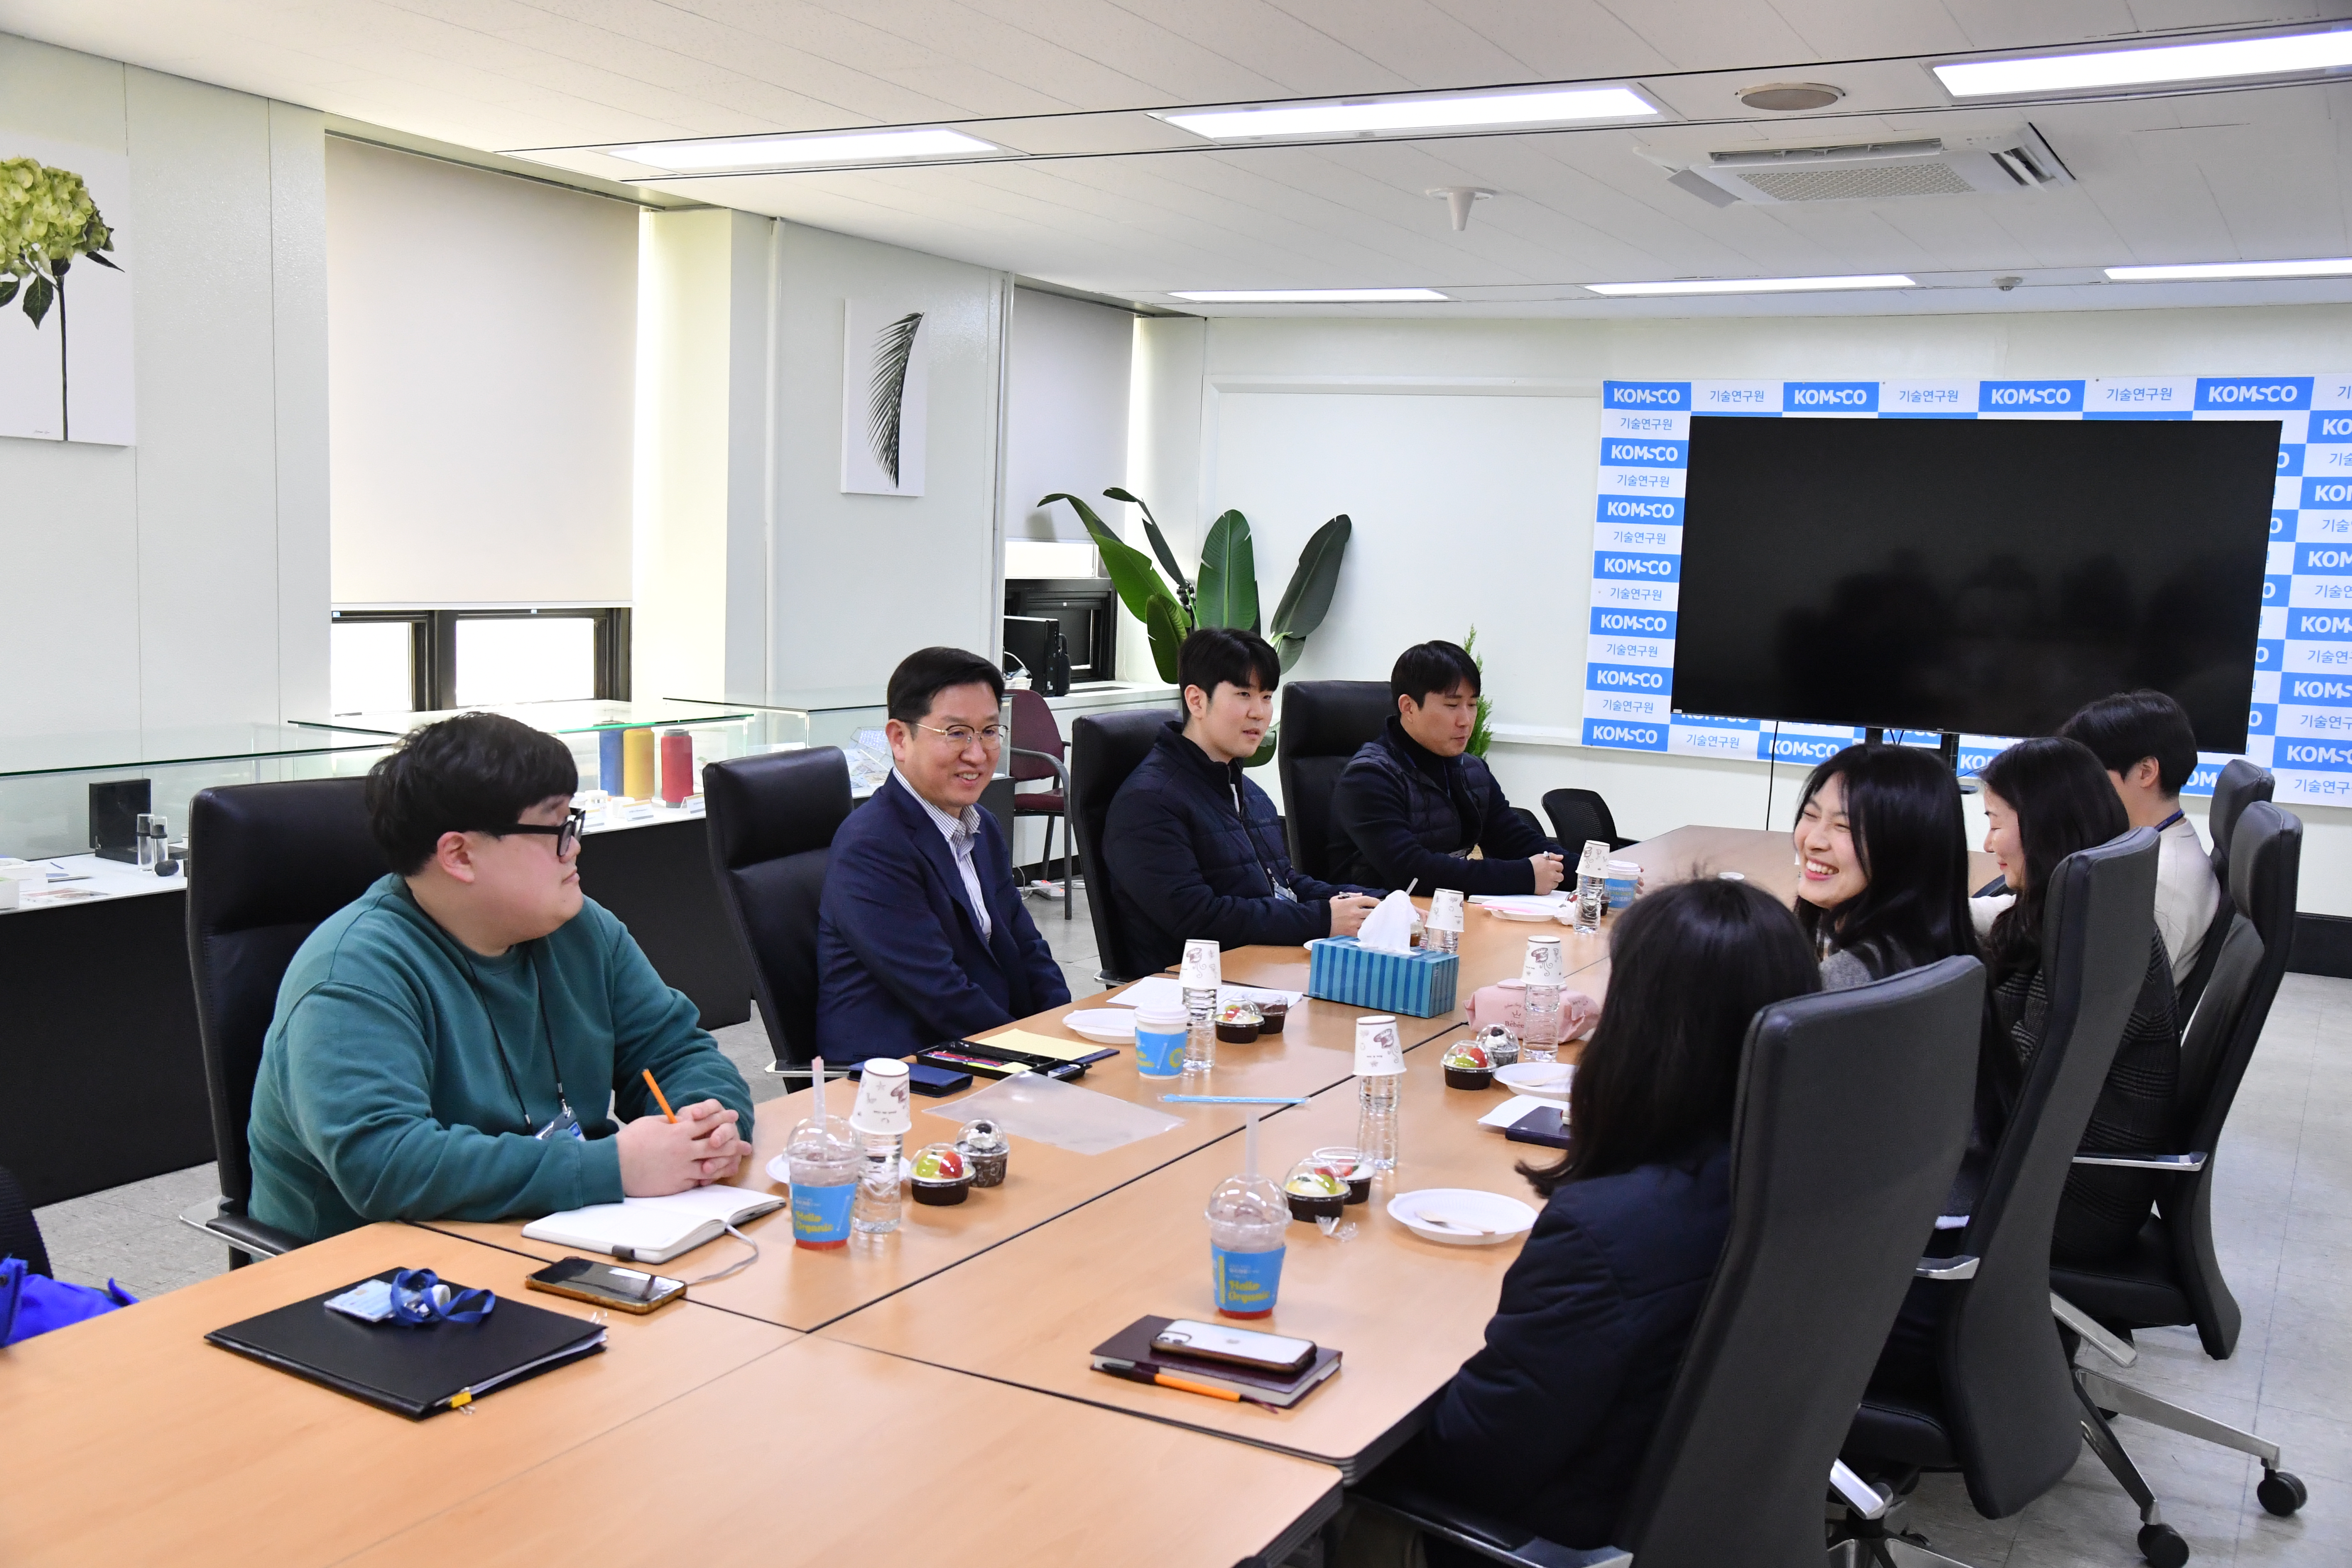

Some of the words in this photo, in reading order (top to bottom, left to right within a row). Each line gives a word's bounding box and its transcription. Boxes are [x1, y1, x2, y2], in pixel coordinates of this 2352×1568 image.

[1614, 388, 1681, 404] KOMSCO
[1710, 390, 1764, 403] 기술연구원
[1794, 389, 1867, 405] KOMSCO
[1900, 389, 1958, 403] 기술연구원
[1991, 388, 2071, 404] KOMSCO
[2107, 387, 2172, 401] 기술연구원
[2208, 385, 2298, 403] KOMSCO
[1621, 418, 1672, 431] 기술연구원
[1611, 445, 1678, 461] KOMSCO
[1617, 475, 1669, 488] 기술연구원
[1607, 501, 1674, 518] KOMSCO
[1613, 531, 1666, 545] 기술연구원
[1604, 558, 1671, 575] KOMSCO
[1610, 588, 1662, 602] 기술연구원
[1601, 614, 1667, 632] KOMSCO
[1606, 643, 1658, 657] 기술연구원
[1597, 670, 1663, 688] KOMSCO
[1603, 700, 1654, 713] 기술연구원
[1592, 725, 1658, 744] KOMSCO
[1687, 734, 1740, 749] 기술연구원
